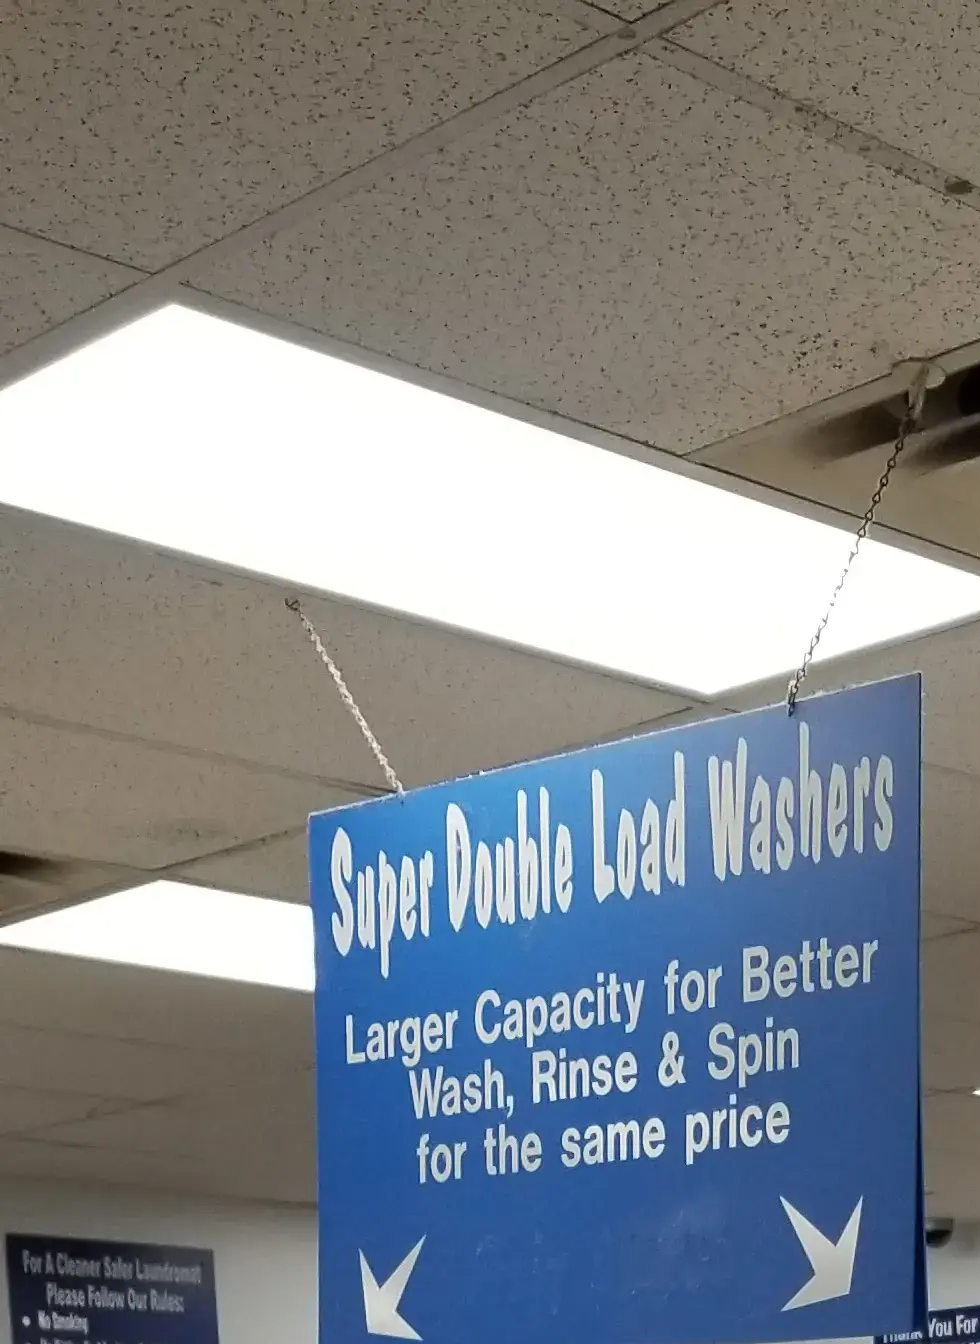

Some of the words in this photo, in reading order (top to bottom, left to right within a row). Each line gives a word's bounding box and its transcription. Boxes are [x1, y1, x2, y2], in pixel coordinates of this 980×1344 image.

[330, 826, 433, 978] Super
[446, 786, 573, 932] Double
[592, 750, 685, 904] Load
[708, 722, 893, 881] Washers
[345, 1008, 458, 1068] Larger
[474, 972, 645, 1047] Capacity
[664, 960, 723, 1015] for
[742, 938, 878, 1002] Better
[409, 1068, 514, 1119] Wash,
[532, 1047, 637, 1104] Rinse
[658, 1032, 685, 1087] &
[708, 1017, 799, 1090] Spin
[416, 1134, 466, 1183] for
[484, 1125, 543, 1176] the
[561, 1116, 665, 1167] same
[685, 1094, 790, 1165] price
[22, 1249, 42, 1274] For
[45, 1253, 55, 1274] A
[56, 1252, 100, 1277] Cleaner
[38, 1310, 50, 1330] No
[46, 1282, 85, 1307] Please
[87, 1284, 124, 1309] Follow
[128, 1288, 148, 1310] Our
[928, 1318, 952, 1338] You
[956, 1315, 978, 1336] For
